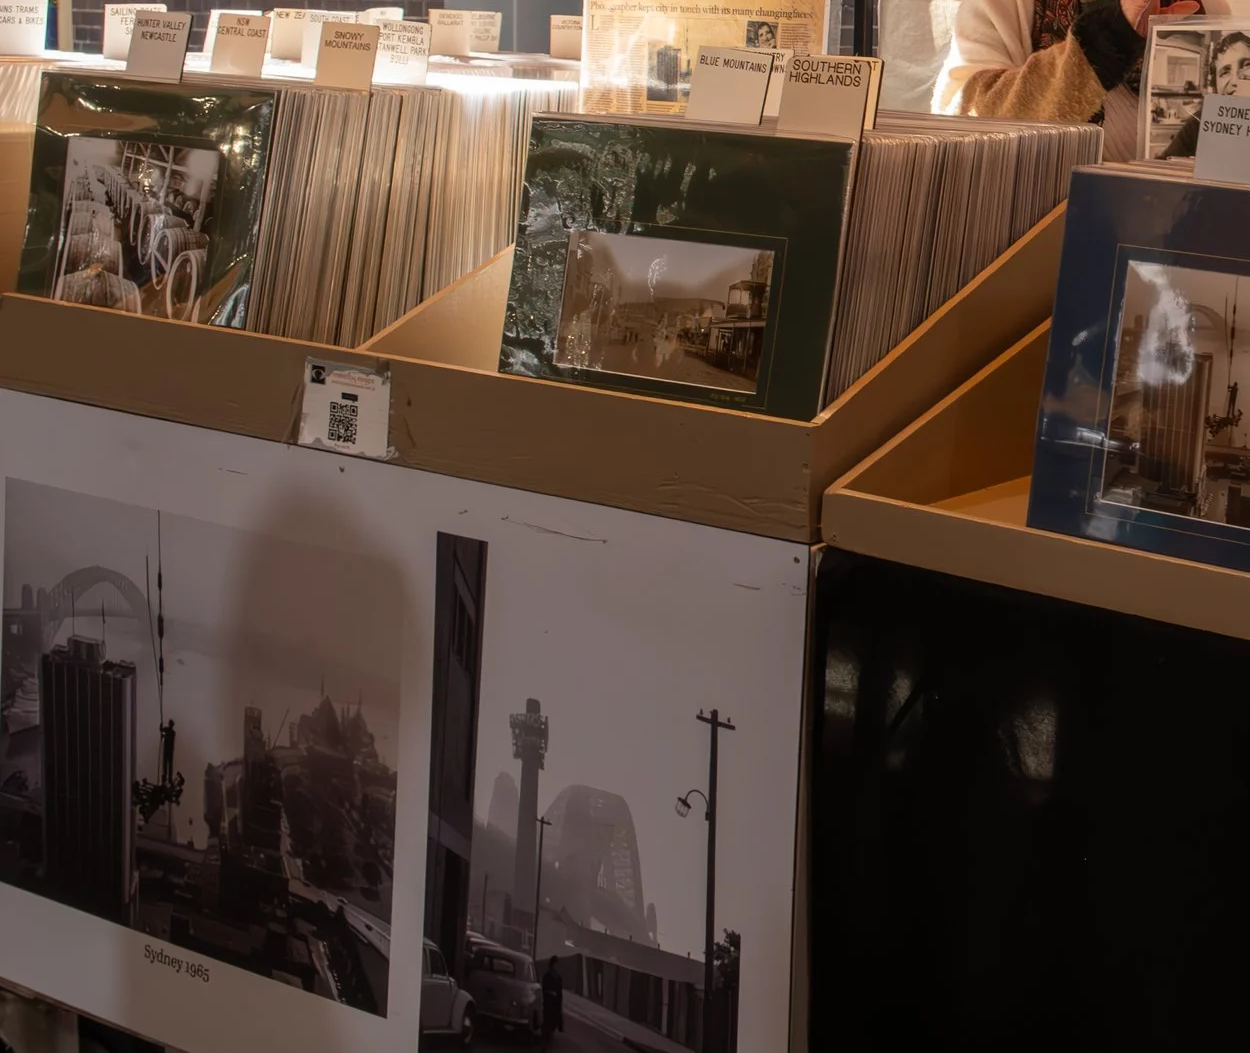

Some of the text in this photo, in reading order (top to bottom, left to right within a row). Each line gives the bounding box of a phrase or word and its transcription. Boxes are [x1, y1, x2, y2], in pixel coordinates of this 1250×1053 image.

[16, 5, 39, 14] TRAMS
[670, 4, 678, 12] in
[680, 4, 700, 14] touch
[702, 5, 720, 14] with
[721, 6, 730, 14] its
[732, 8, 754, 18] many
[137, 18, 161, 29] HUNTER
[162, 20, 187, 31] VALLEY
[141, 31, 177, 43] NEWCASTLE
[217, 26, 266, 38] CENTRAL COAST
[334, 31, 364, 41] SNOWY
[324, 40, 371, 52] MOUNTAINS
[397, 33, 424, 46] KEMBLA
[379, 41, 428, 57] TANWELL PARK
[699, 54, 720, 67] BLUE
[722, 57, 768, 74] MOUNTAINS
[792, 59, 862, 75] SOUTHERN
[788, 72, 862, 88] HIGHLANDS
[1202, 121, 1243, 137] SYDNEY
[144, 944, 210, 983] Sydney 1965
